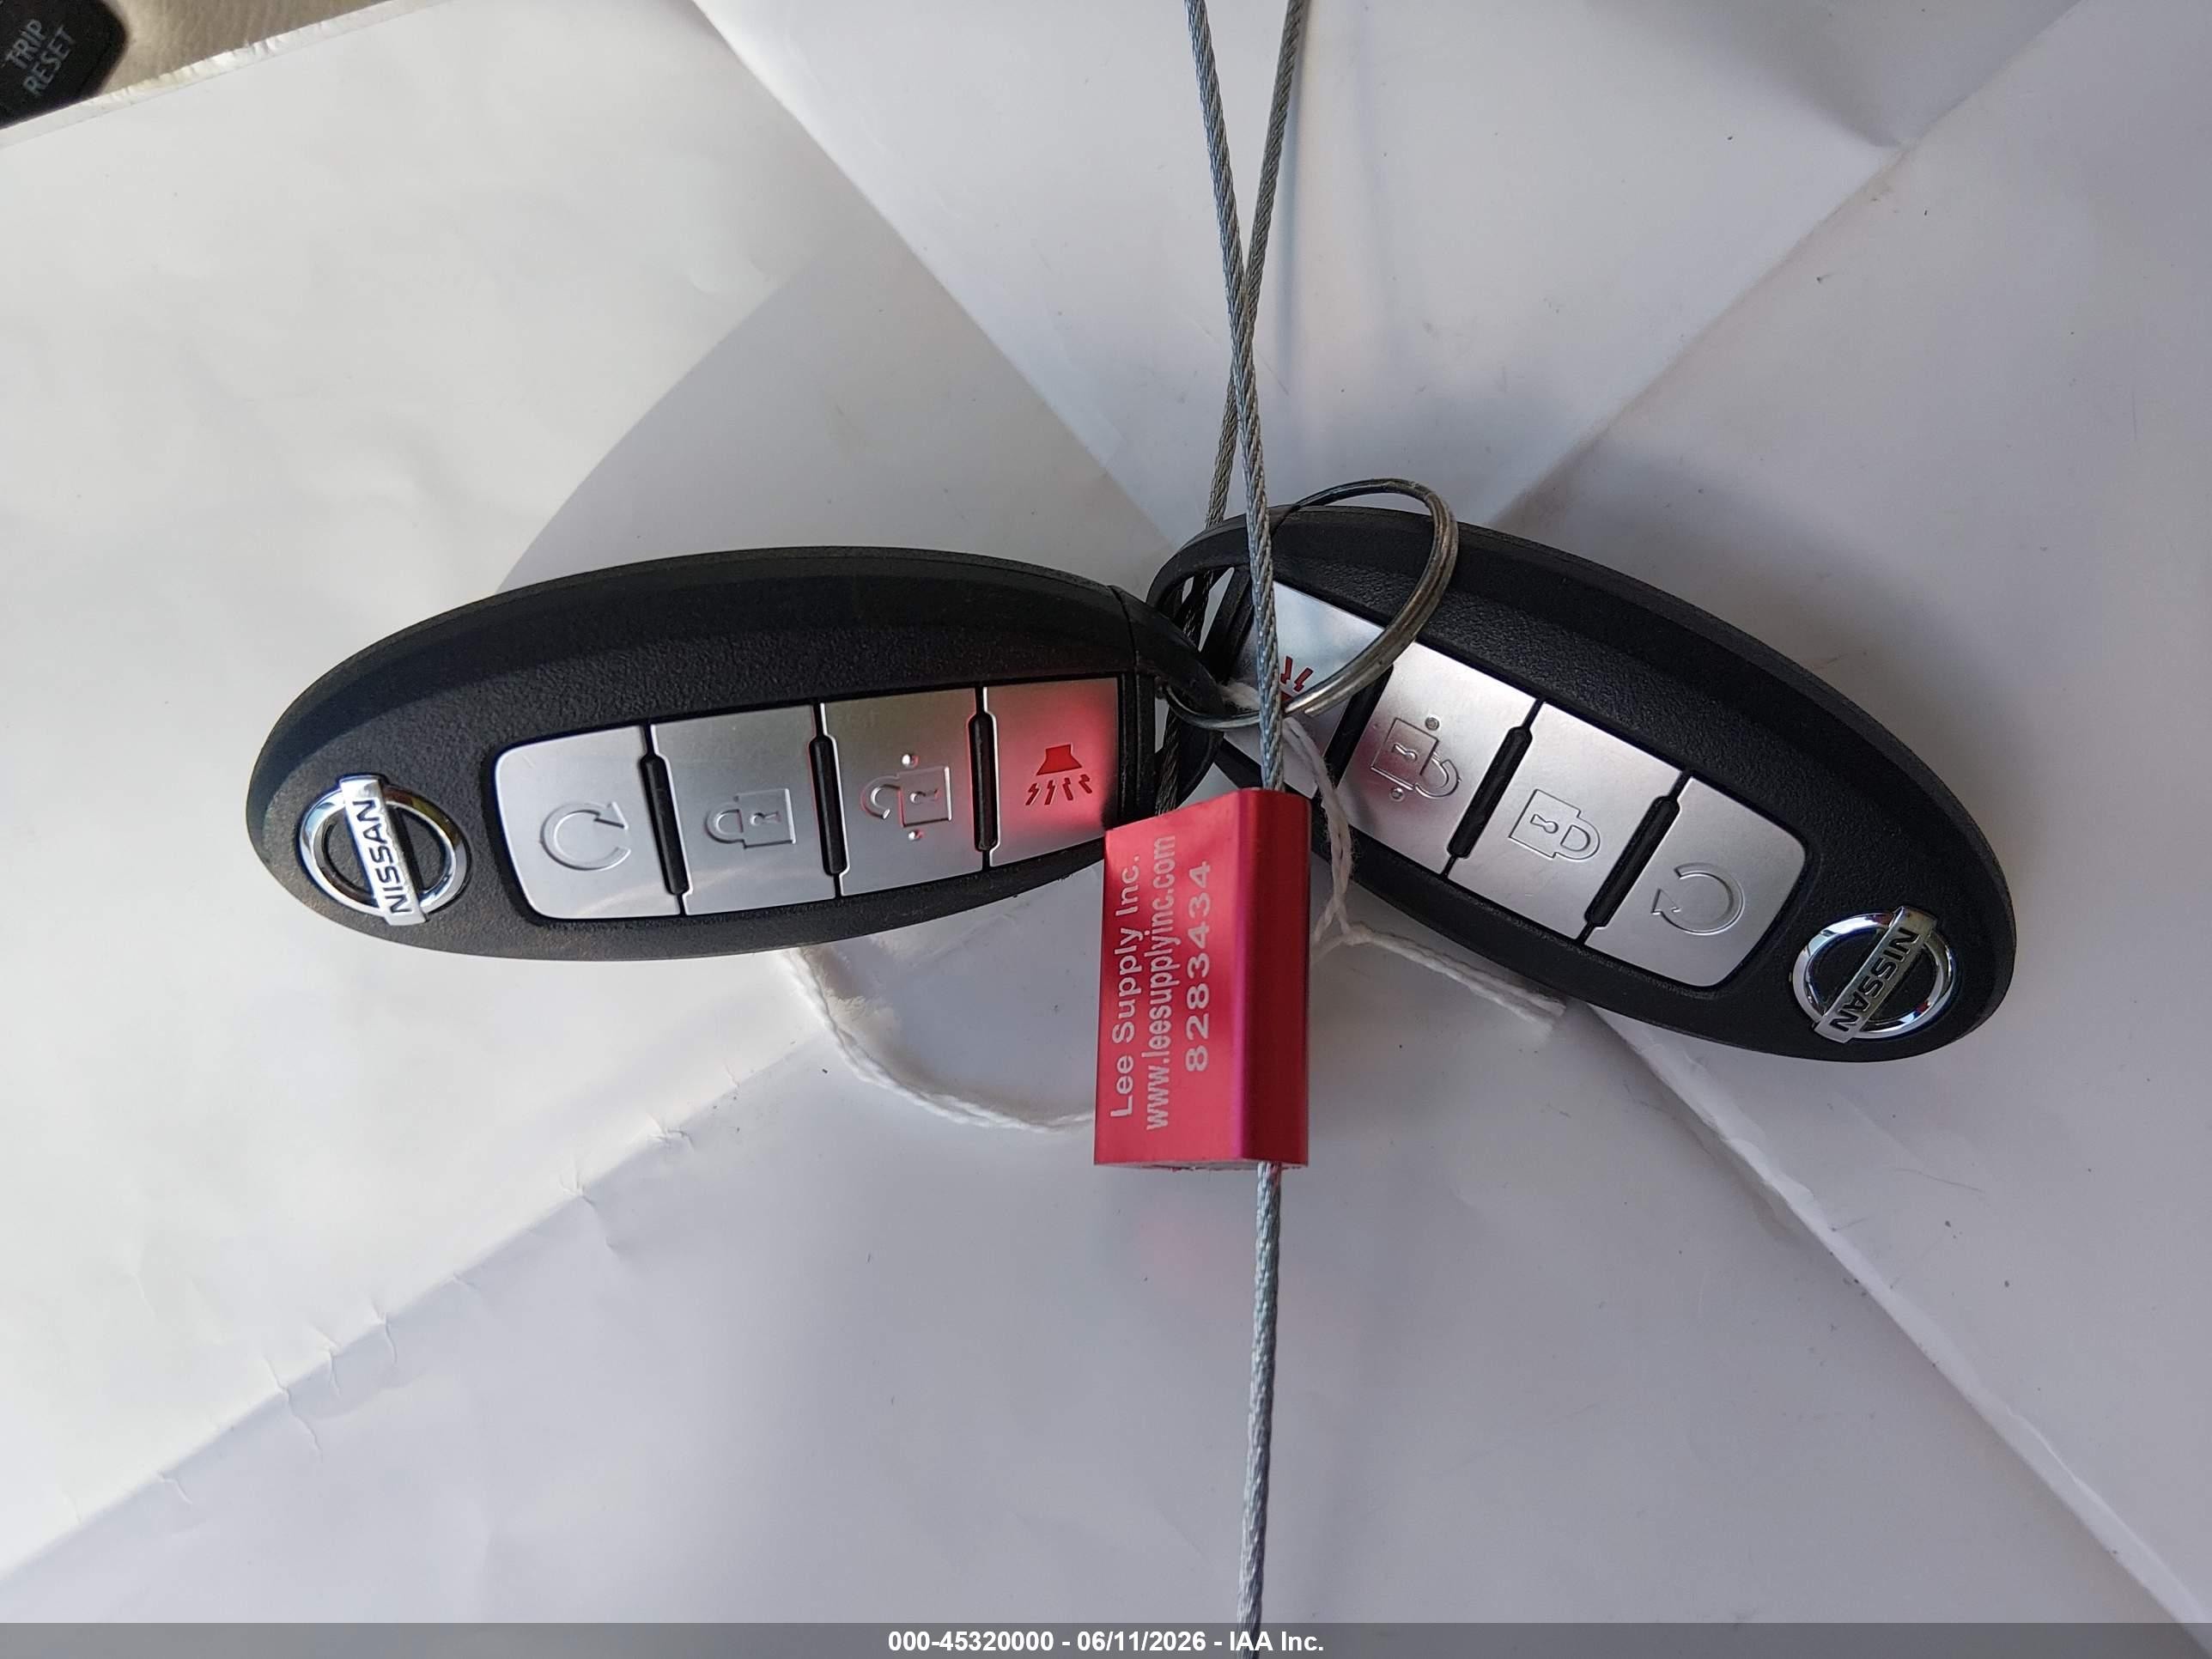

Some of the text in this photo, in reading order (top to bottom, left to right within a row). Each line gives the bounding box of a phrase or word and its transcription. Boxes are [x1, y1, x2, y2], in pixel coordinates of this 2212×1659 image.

[4, 19, 46, 70] TRIP
[22, 25, 76, 97] RESET
[352, 799, 413, 913] NISSAN
[1110, 854, 1144, 1117] Lee Supply Inc.
[1141, 836, 1181, 1131] www.leesupplyinc.com
[1185, 860, 1212, 1073] 8283434
[1828, 927, 1921, 1032] NISSAN
